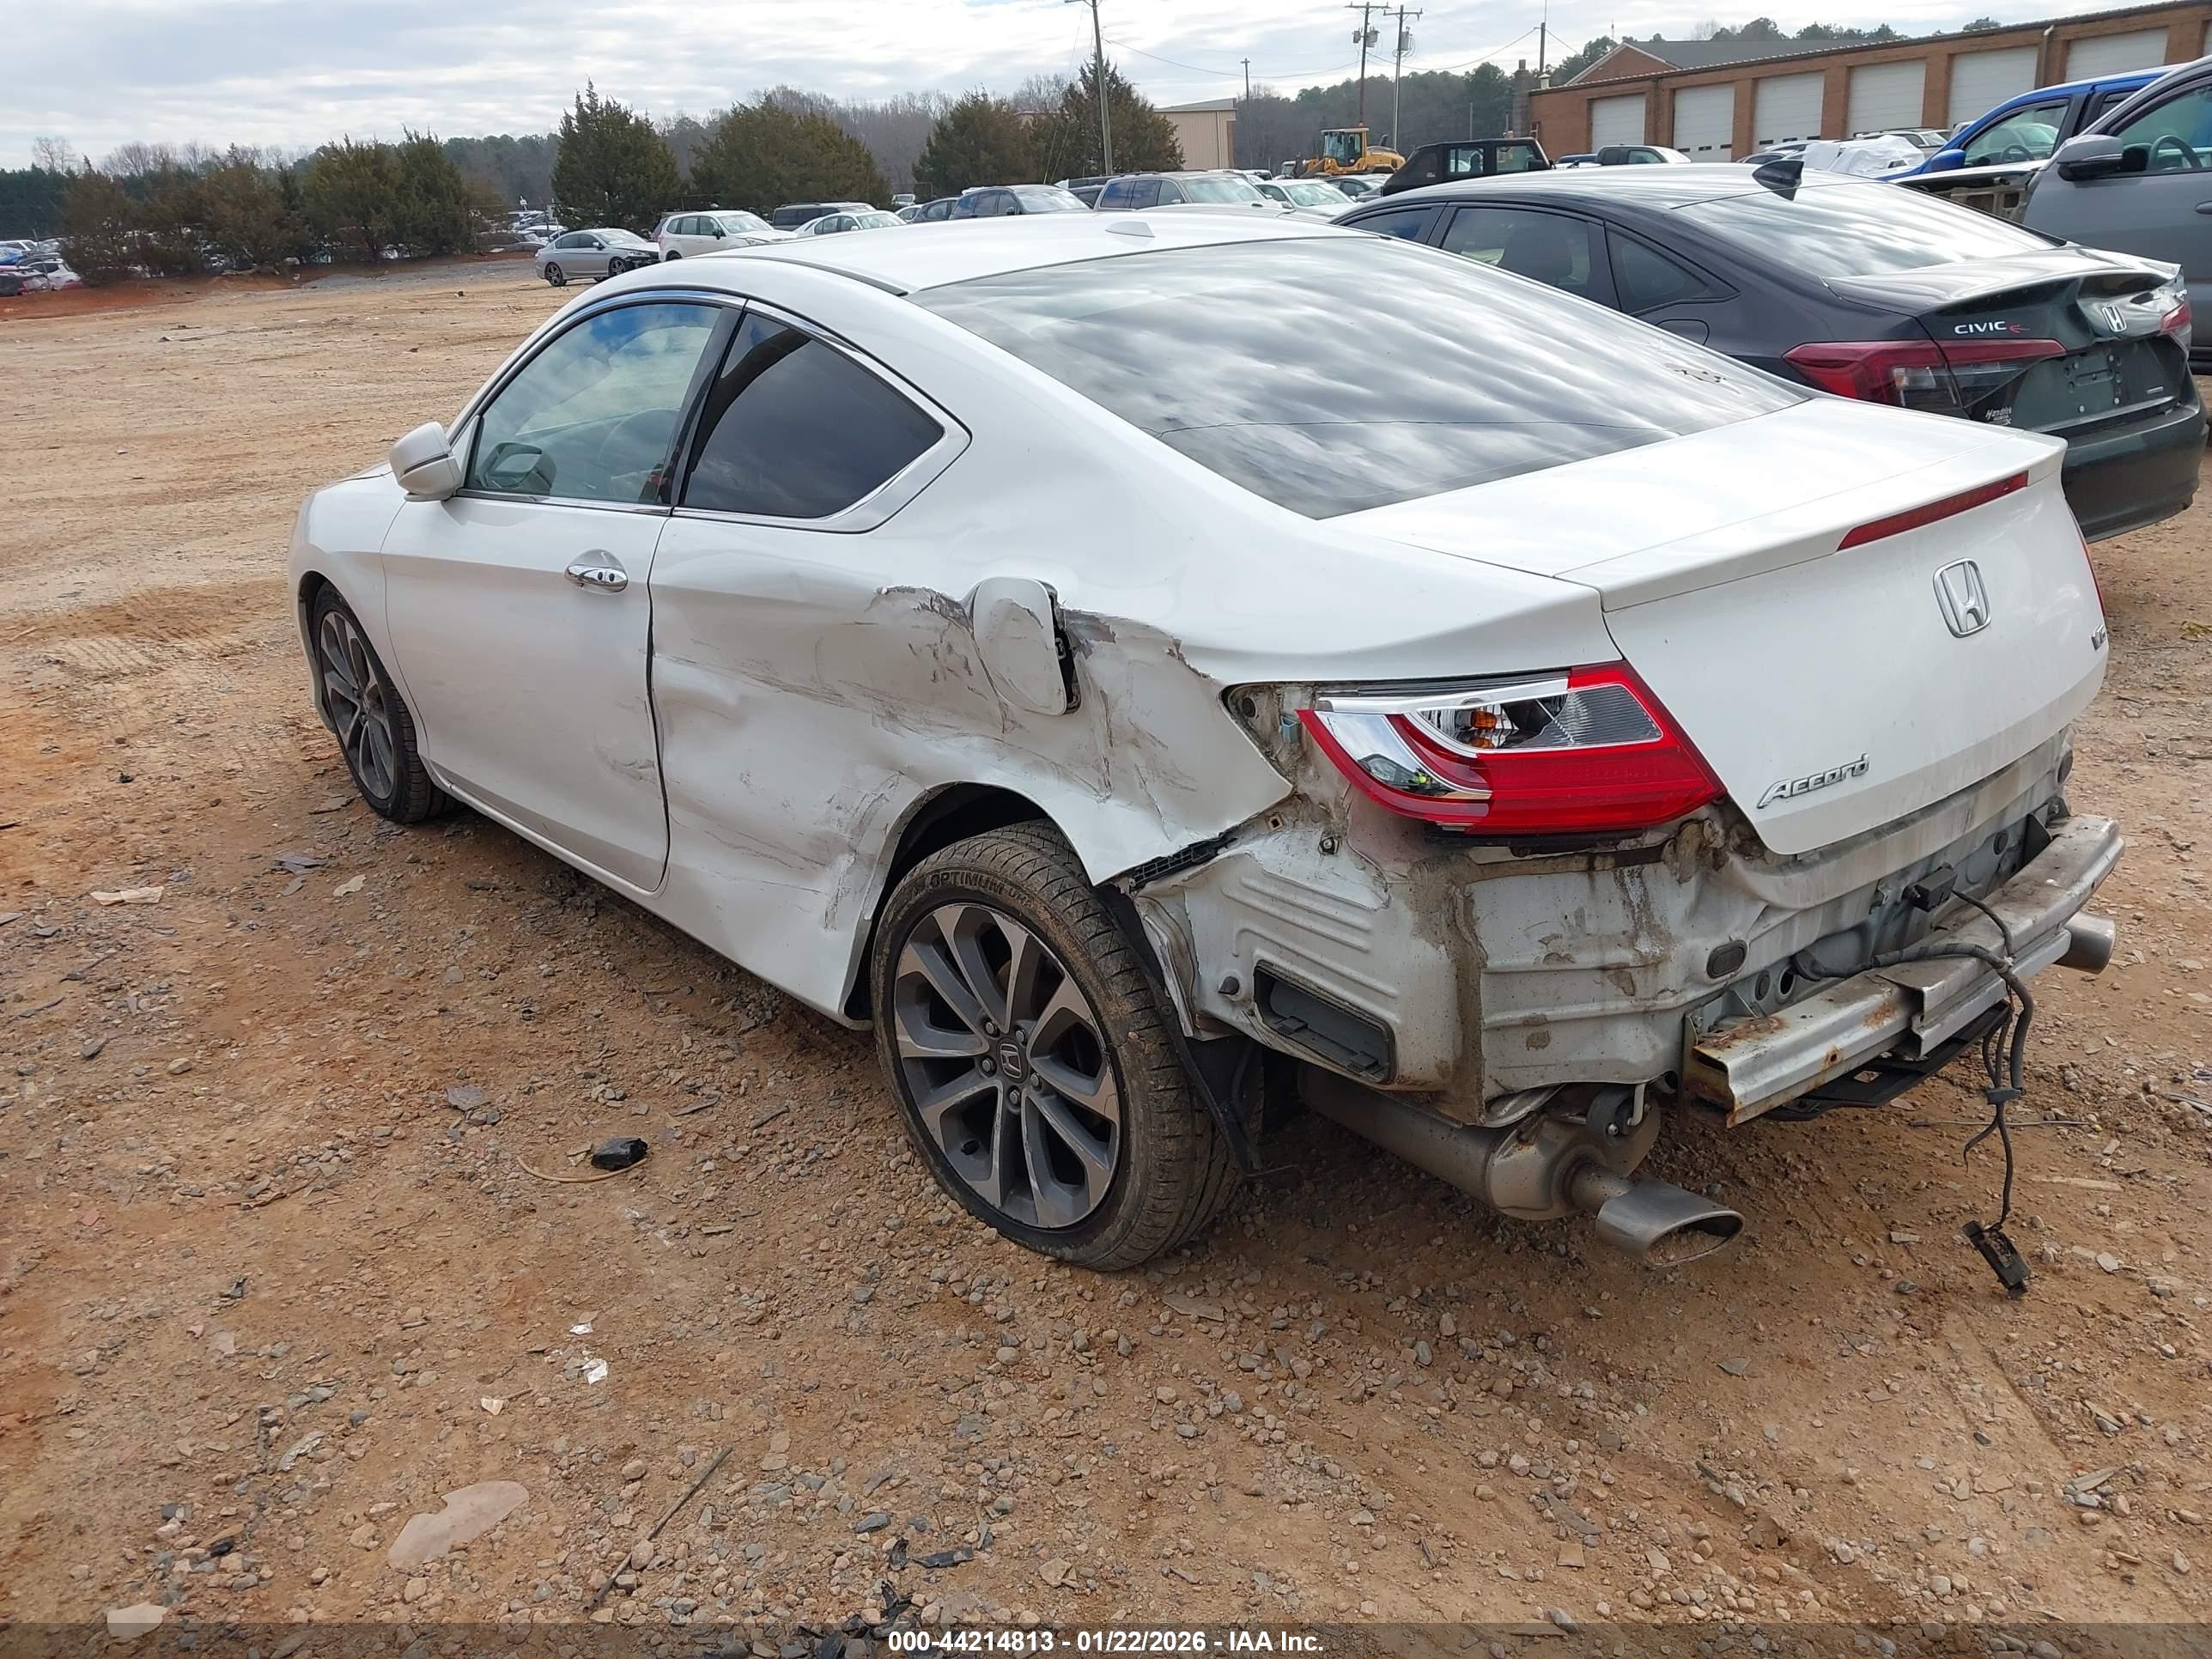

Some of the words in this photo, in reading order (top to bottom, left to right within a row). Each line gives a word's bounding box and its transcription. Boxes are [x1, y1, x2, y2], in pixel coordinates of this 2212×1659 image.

[1954, 320, 2007, 334] CIVIC
[1757, 751, 1870, 809] Accord
[930, 871, 1006, 895] OPTIMUM
